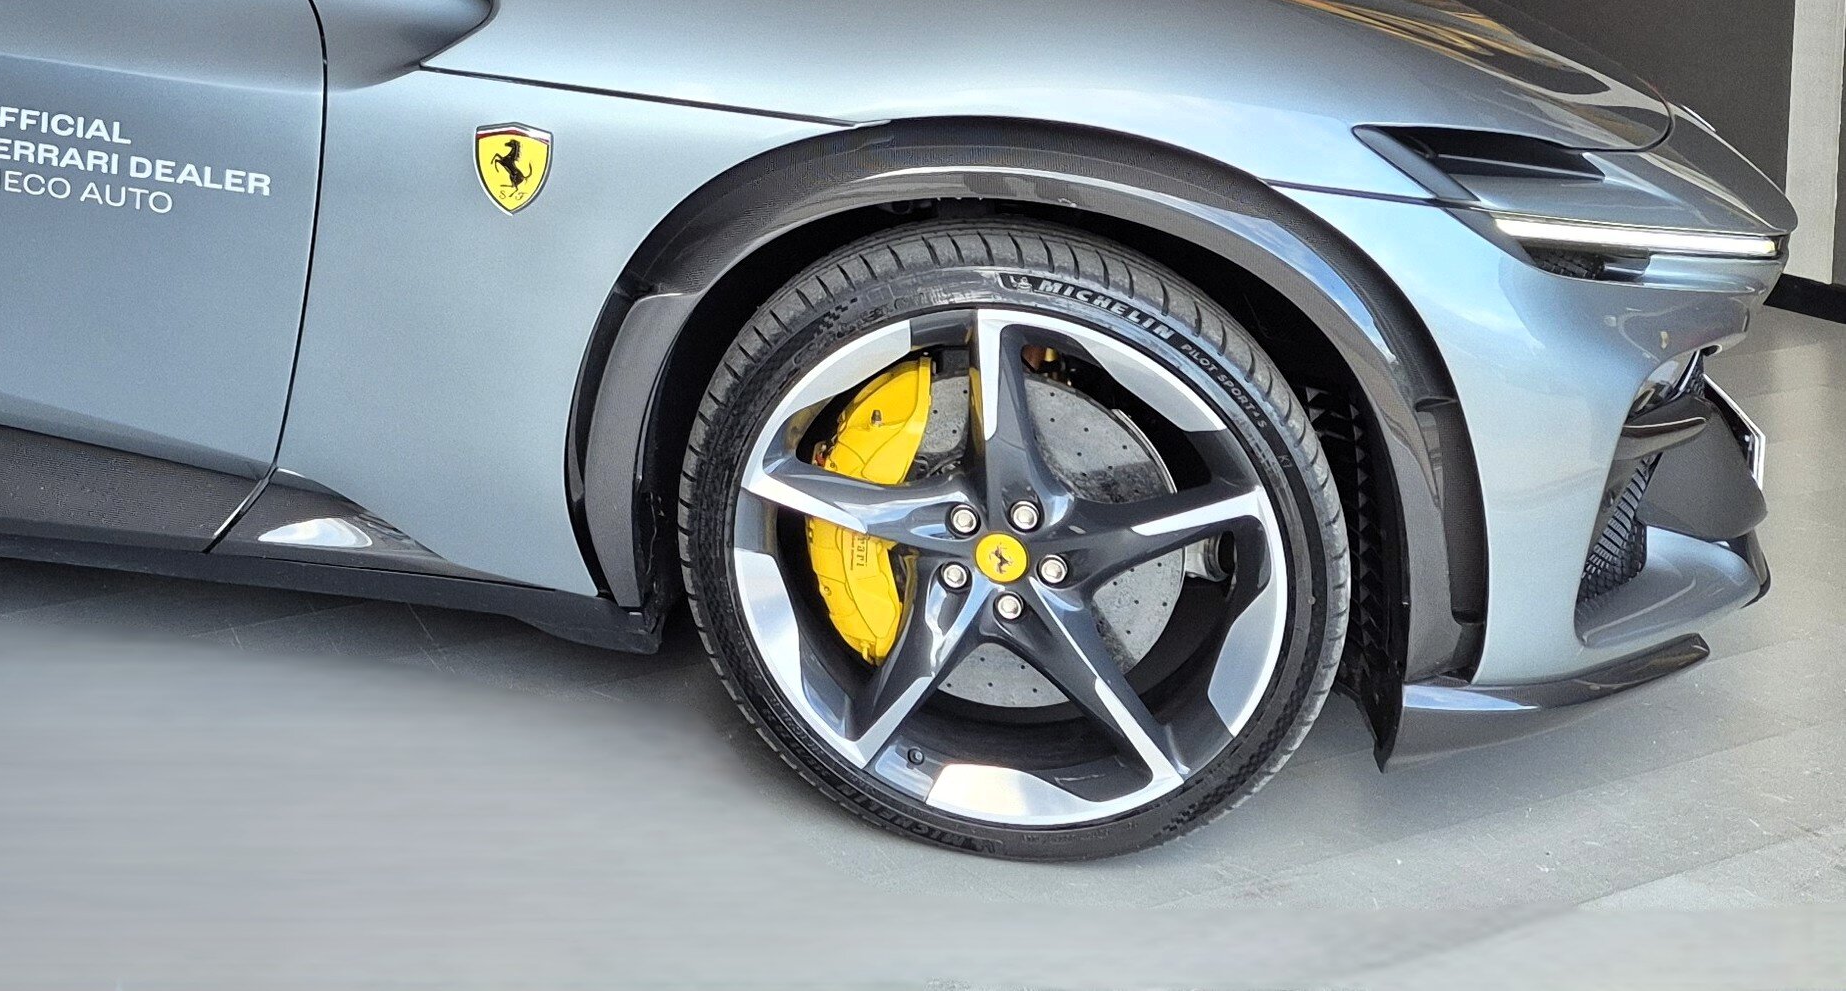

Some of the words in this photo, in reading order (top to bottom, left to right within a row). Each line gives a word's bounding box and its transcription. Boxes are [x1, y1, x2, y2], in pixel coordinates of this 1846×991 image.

[129, 155, 272, 197] DEALER
[80, 182, 173, 215] AUTO
[1039, 279, 1176, 340] MICHELIN
[1180, 343, 1219, 372] PILOT
[1217, 373, 1255, 413] SPORT
